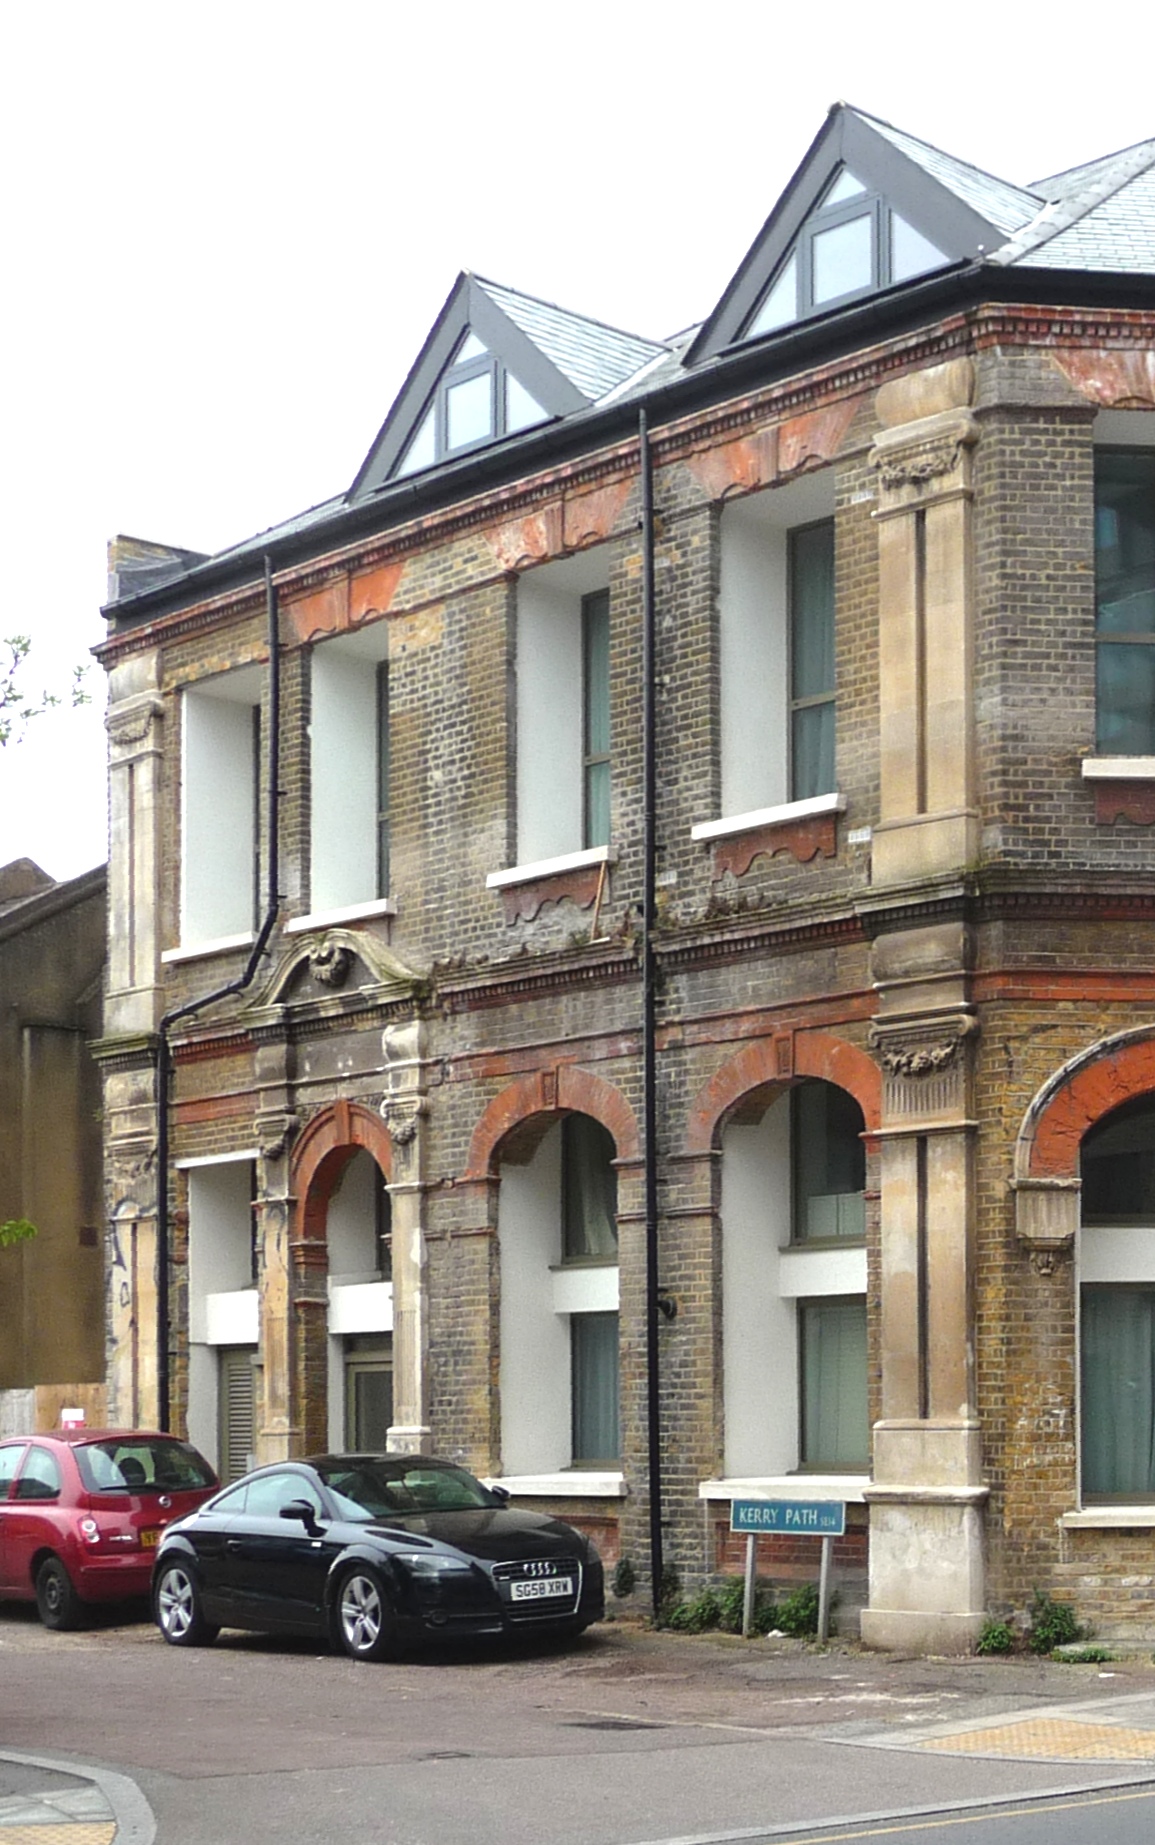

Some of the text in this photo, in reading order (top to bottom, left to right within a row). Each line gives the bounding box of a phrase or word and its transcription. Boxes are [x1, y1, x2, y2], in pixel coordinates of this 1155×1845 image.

[739, 1507, 778, 1524] KERRY
[785, 1508, 817, 1526] PATH
[515, 1580, 569, 1598] SG58 XRW
